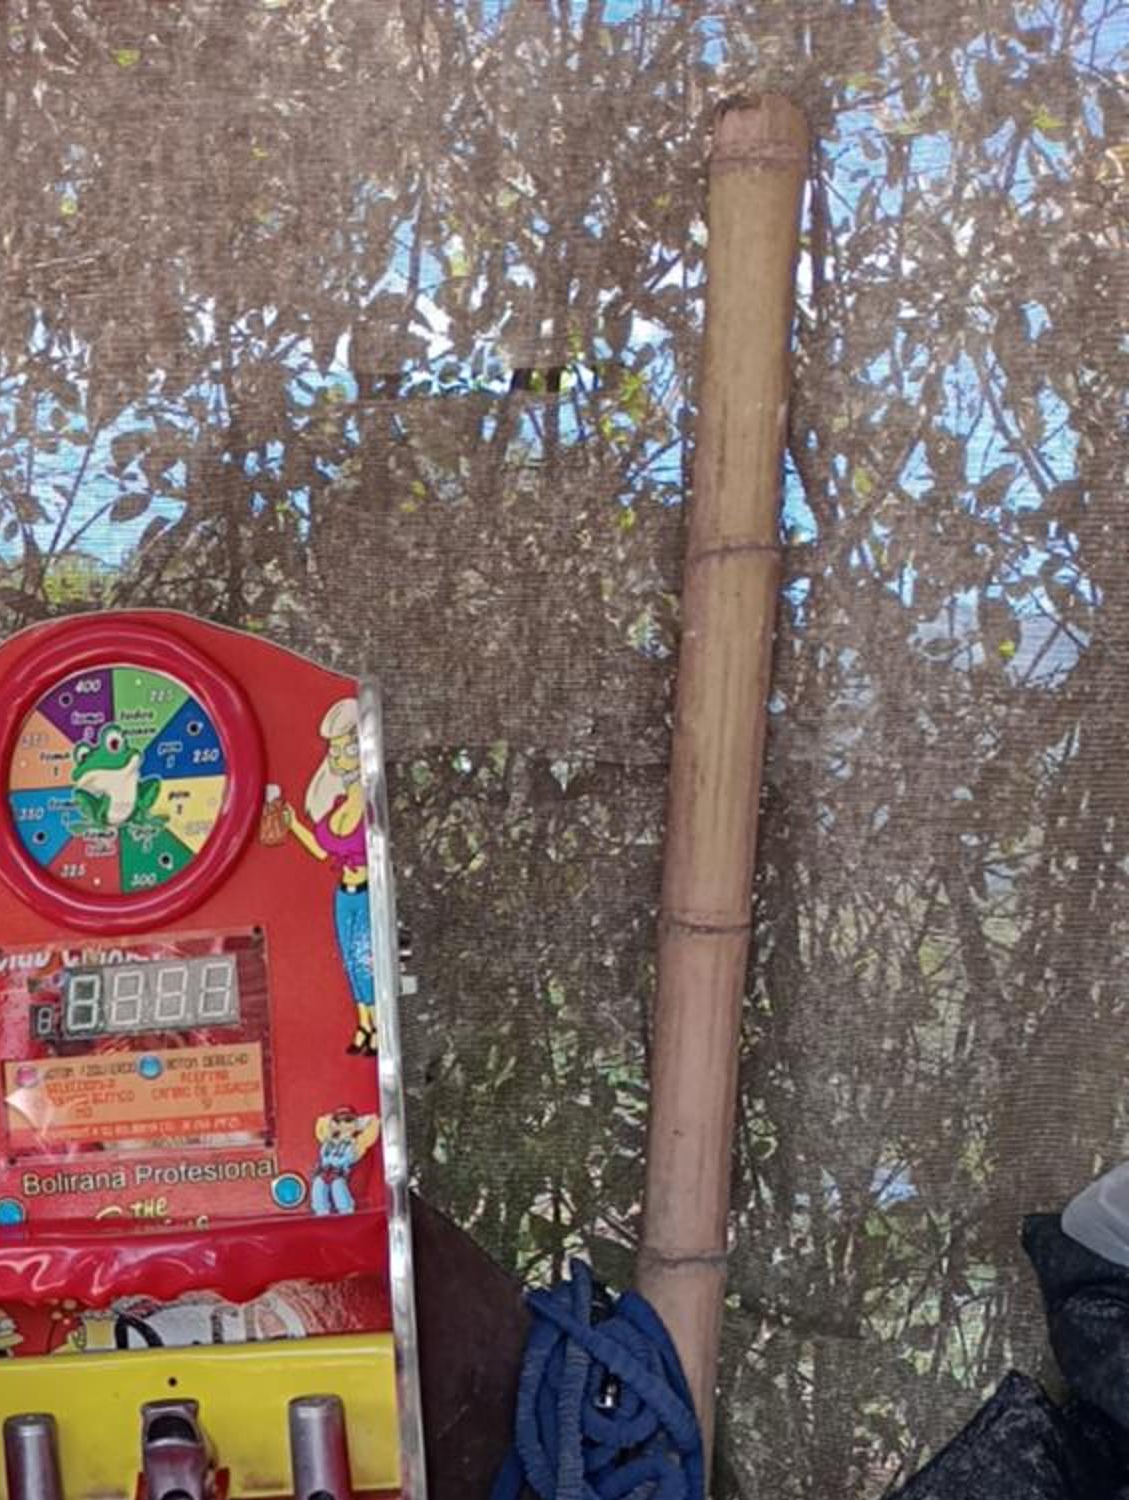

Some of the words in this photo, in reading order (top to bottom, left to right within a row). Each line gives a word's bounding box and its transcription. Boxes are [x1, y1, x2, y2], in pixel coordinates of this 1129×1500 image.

[75, 679, 102, 693] 400
[22, 1169, 127, 1197] Bolirana
[134, 1155, 280, 1187] Profesional
